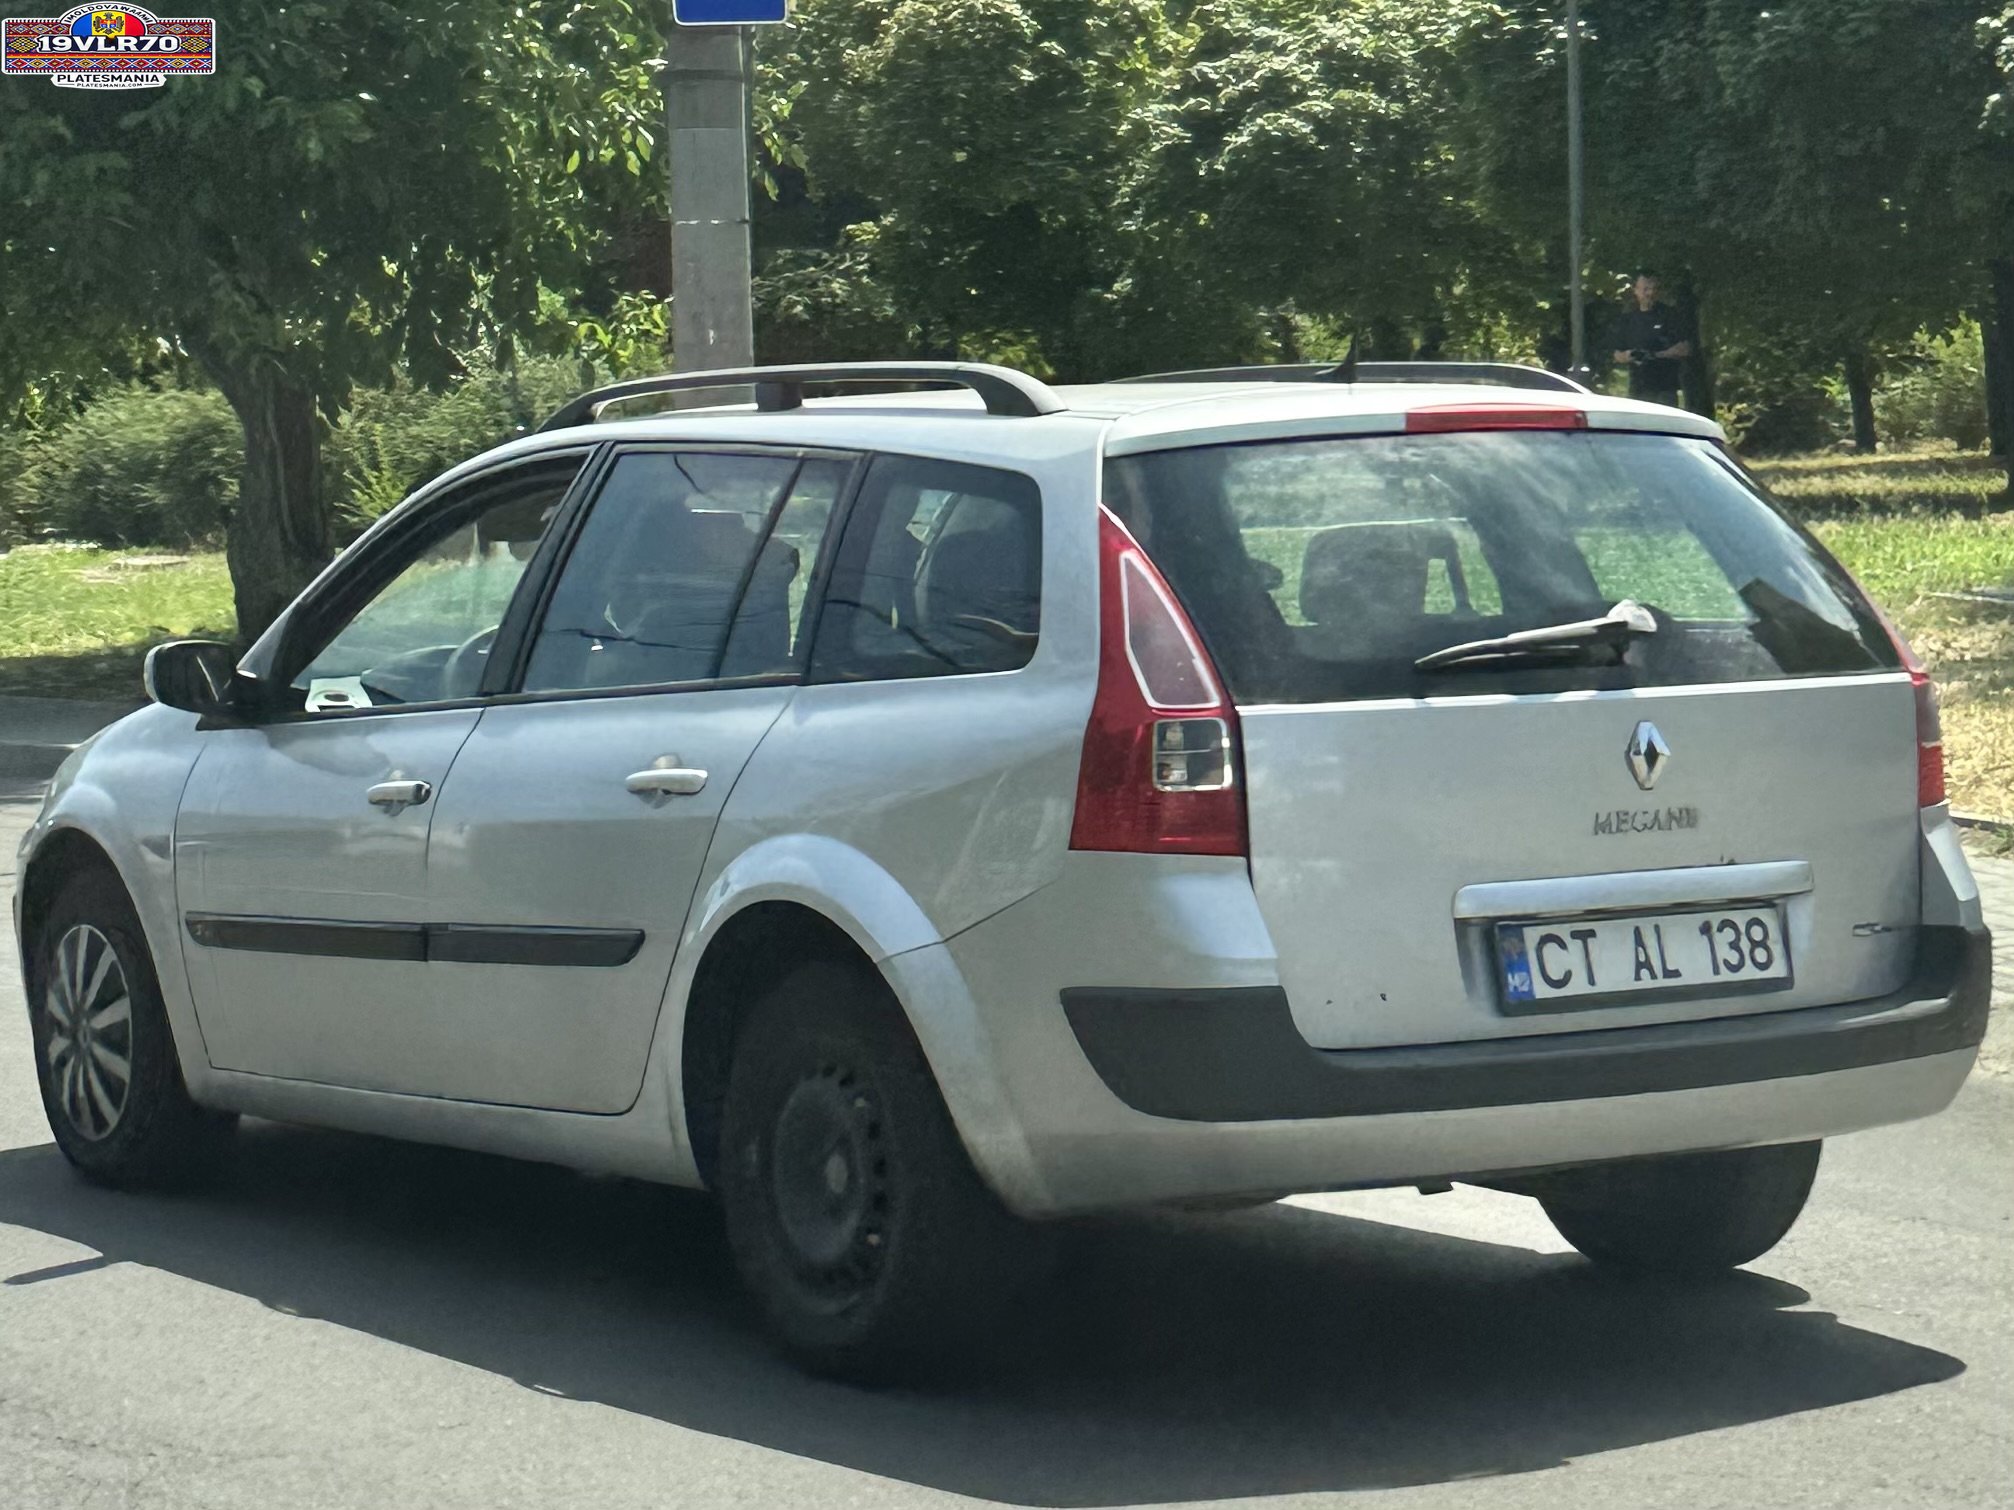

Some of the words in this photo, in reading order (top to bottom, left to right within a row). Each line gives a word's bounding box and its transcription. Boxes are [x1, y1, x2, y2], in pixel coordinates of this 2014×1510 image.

[1535, 928, 1598, 990] CT
[1633, 924, 1682, 982] AL
[1698, 917, 1774, 976] 138
